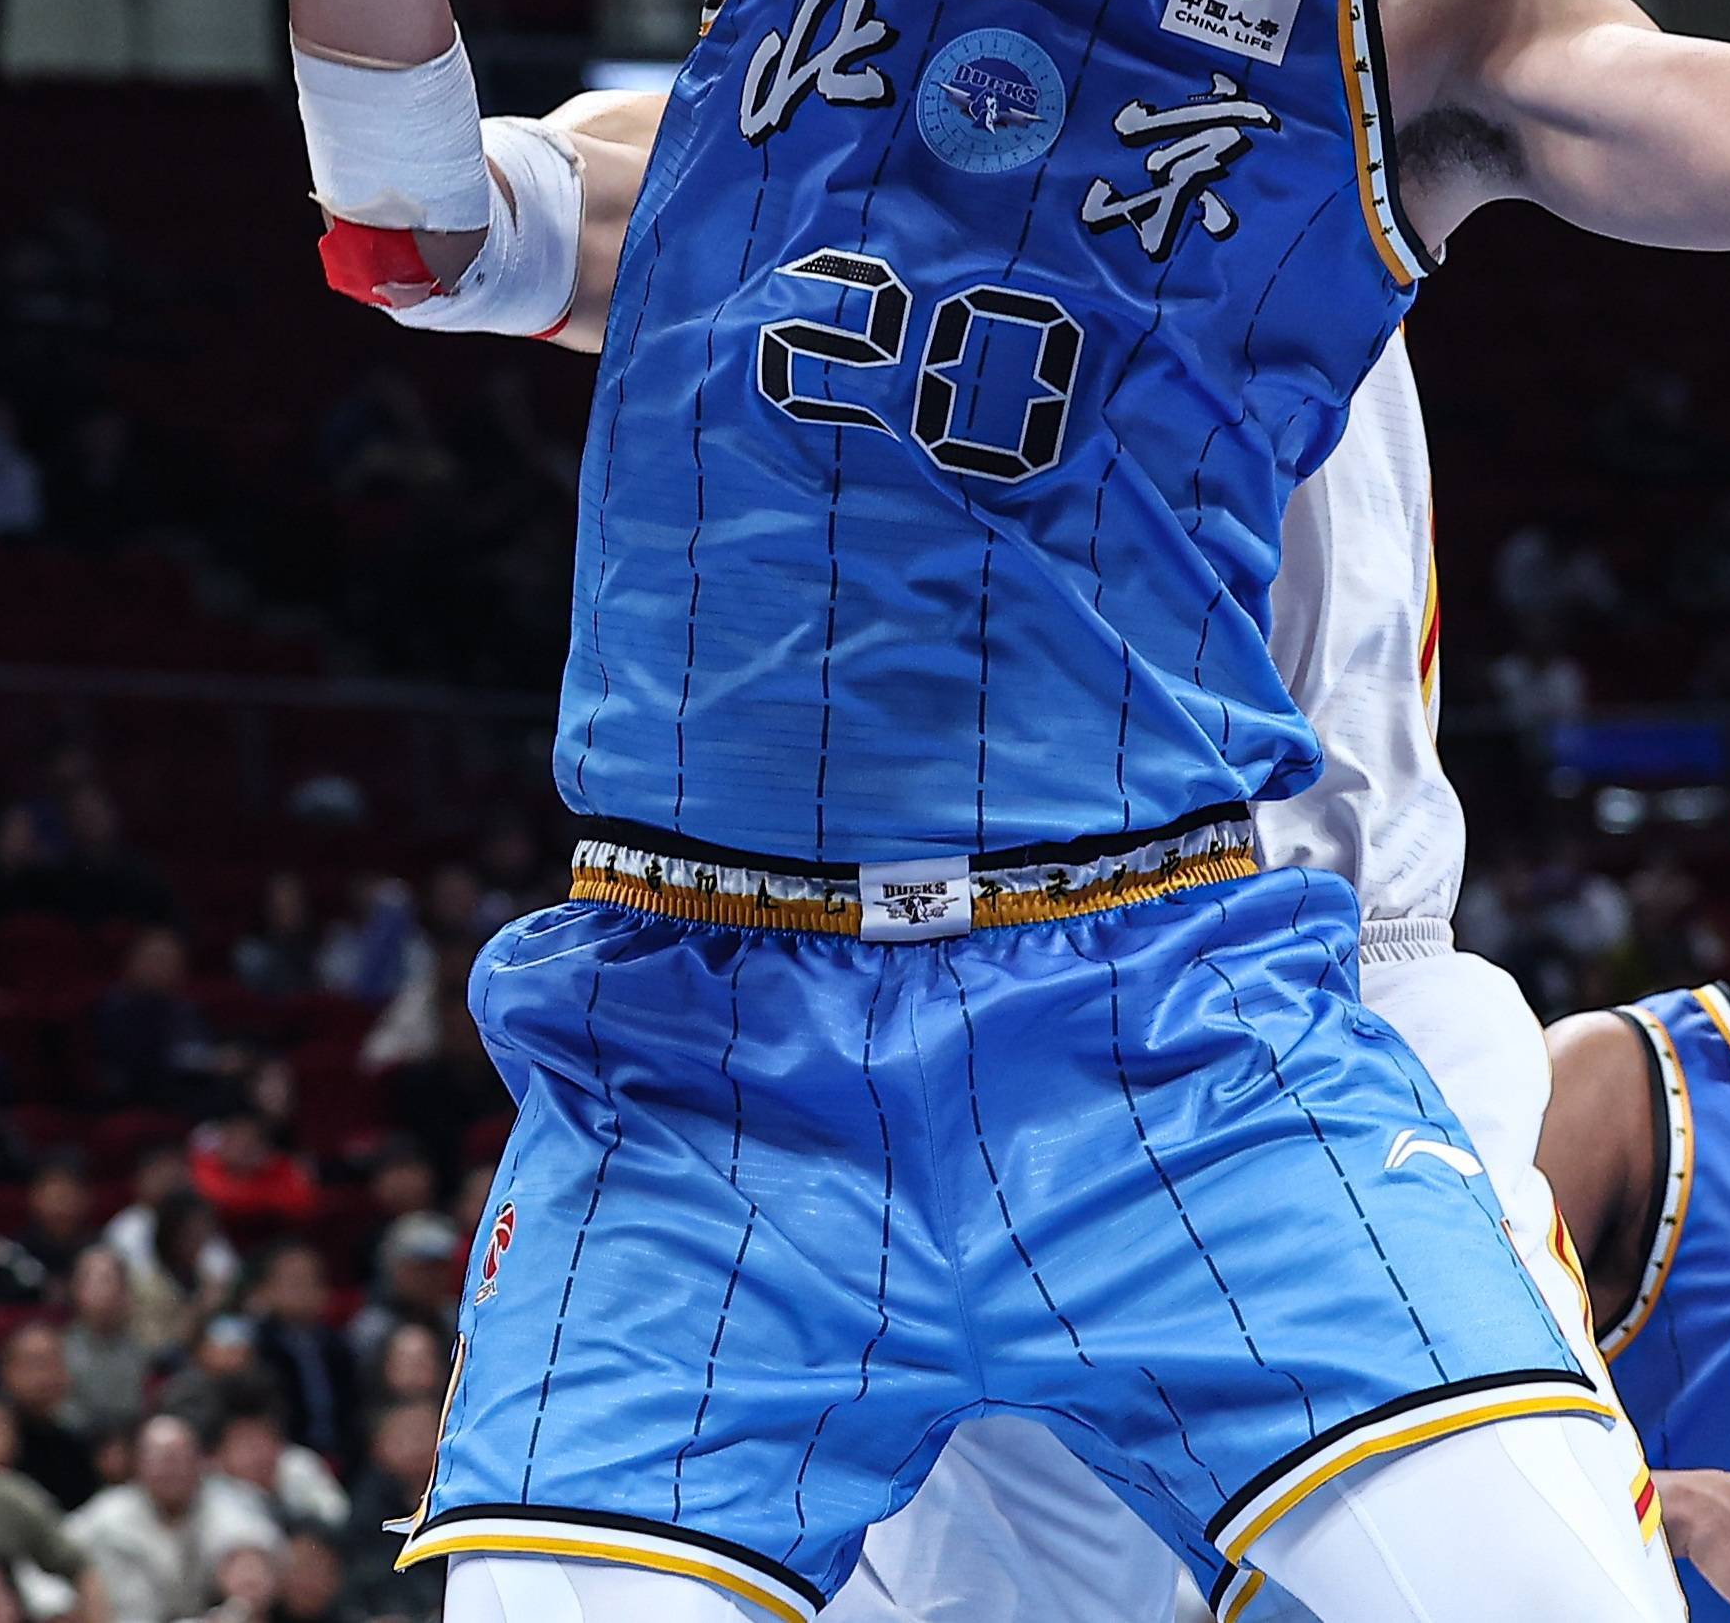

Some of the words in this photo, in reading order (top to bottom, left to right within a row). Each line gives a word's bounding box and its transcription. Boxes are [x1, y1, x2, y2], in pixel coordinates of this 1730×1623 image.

[1175, 9, 1229, 38] CHINA
[1234, 30, 1273, 52] LIFE
[952, 63, 1041, 109] DUCKS
[757, 247, 1085, 484] 20
[882, 881, 948, 899] DUCKS
